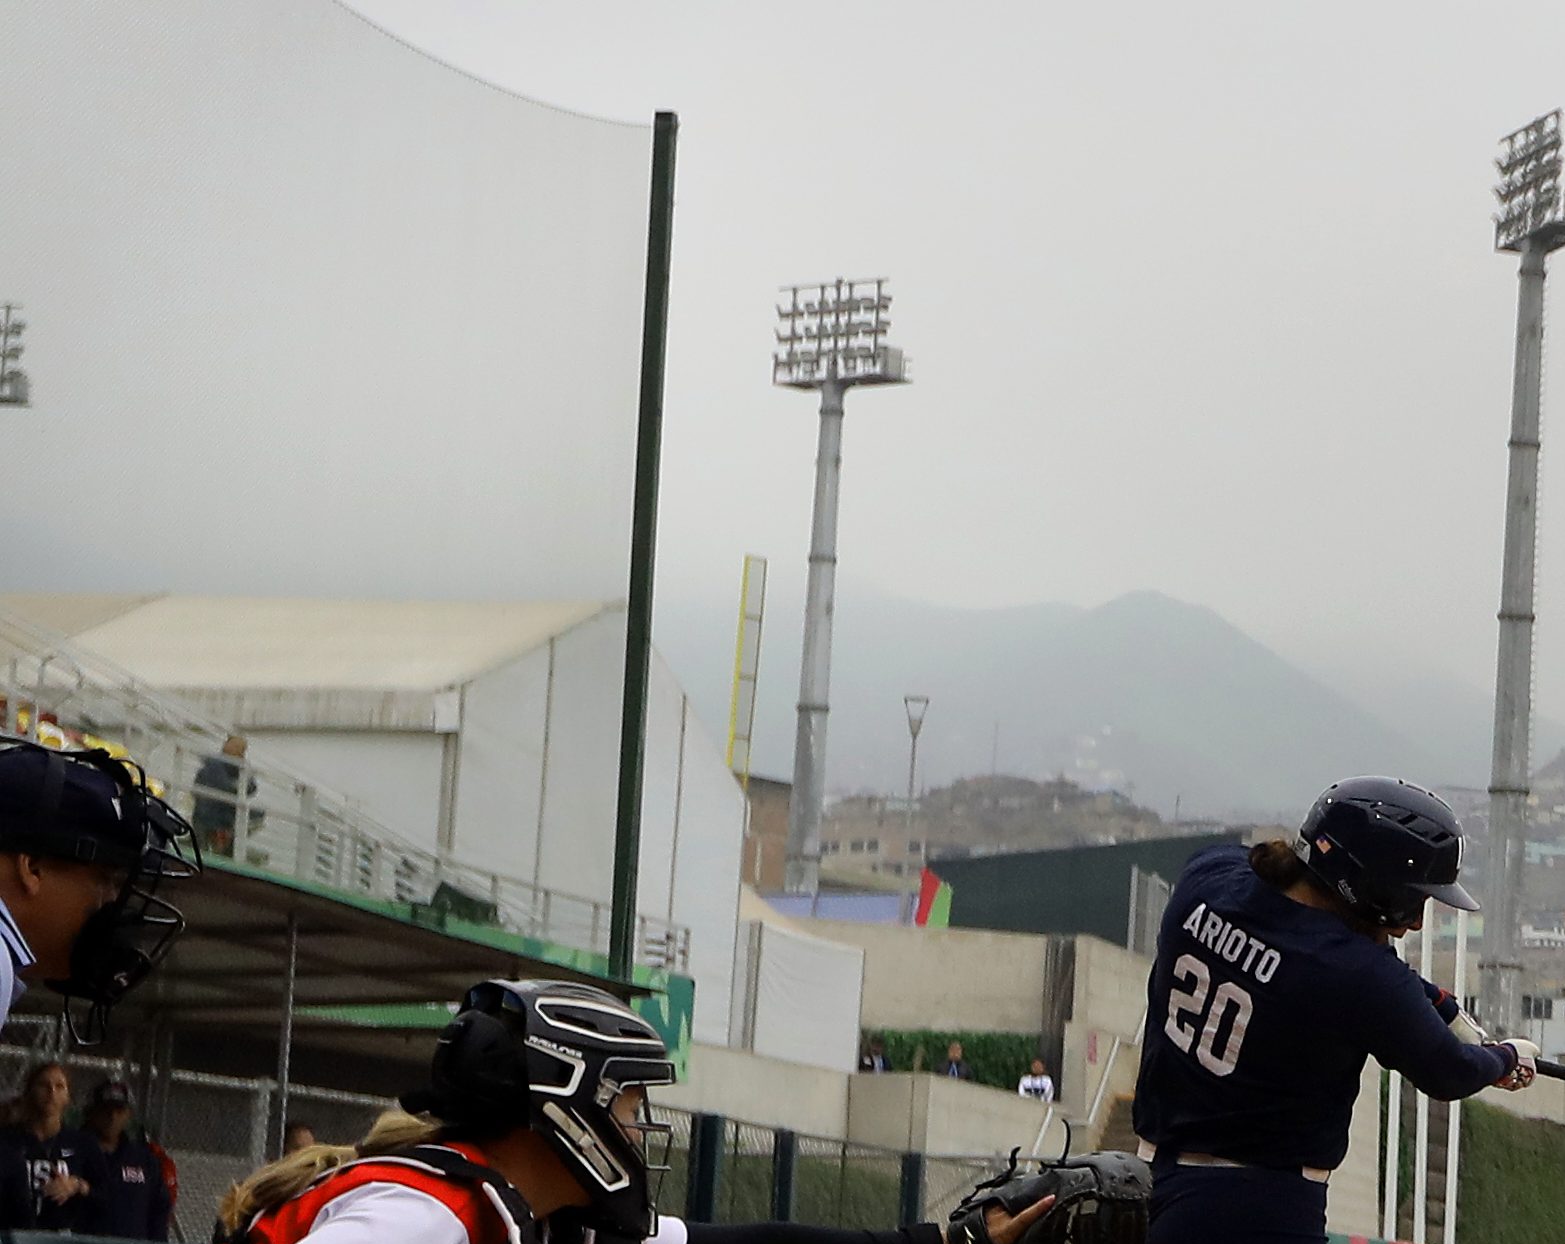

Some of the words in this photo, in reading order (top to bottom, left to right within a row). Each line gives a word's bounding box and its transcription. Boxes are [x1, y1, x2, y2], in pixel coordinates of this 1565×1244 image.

[1182, 903, 1280, 984] ARIOTO
[1164, 954, 1253, 1077] 20
[122, 1165, 146, 1184] USA
